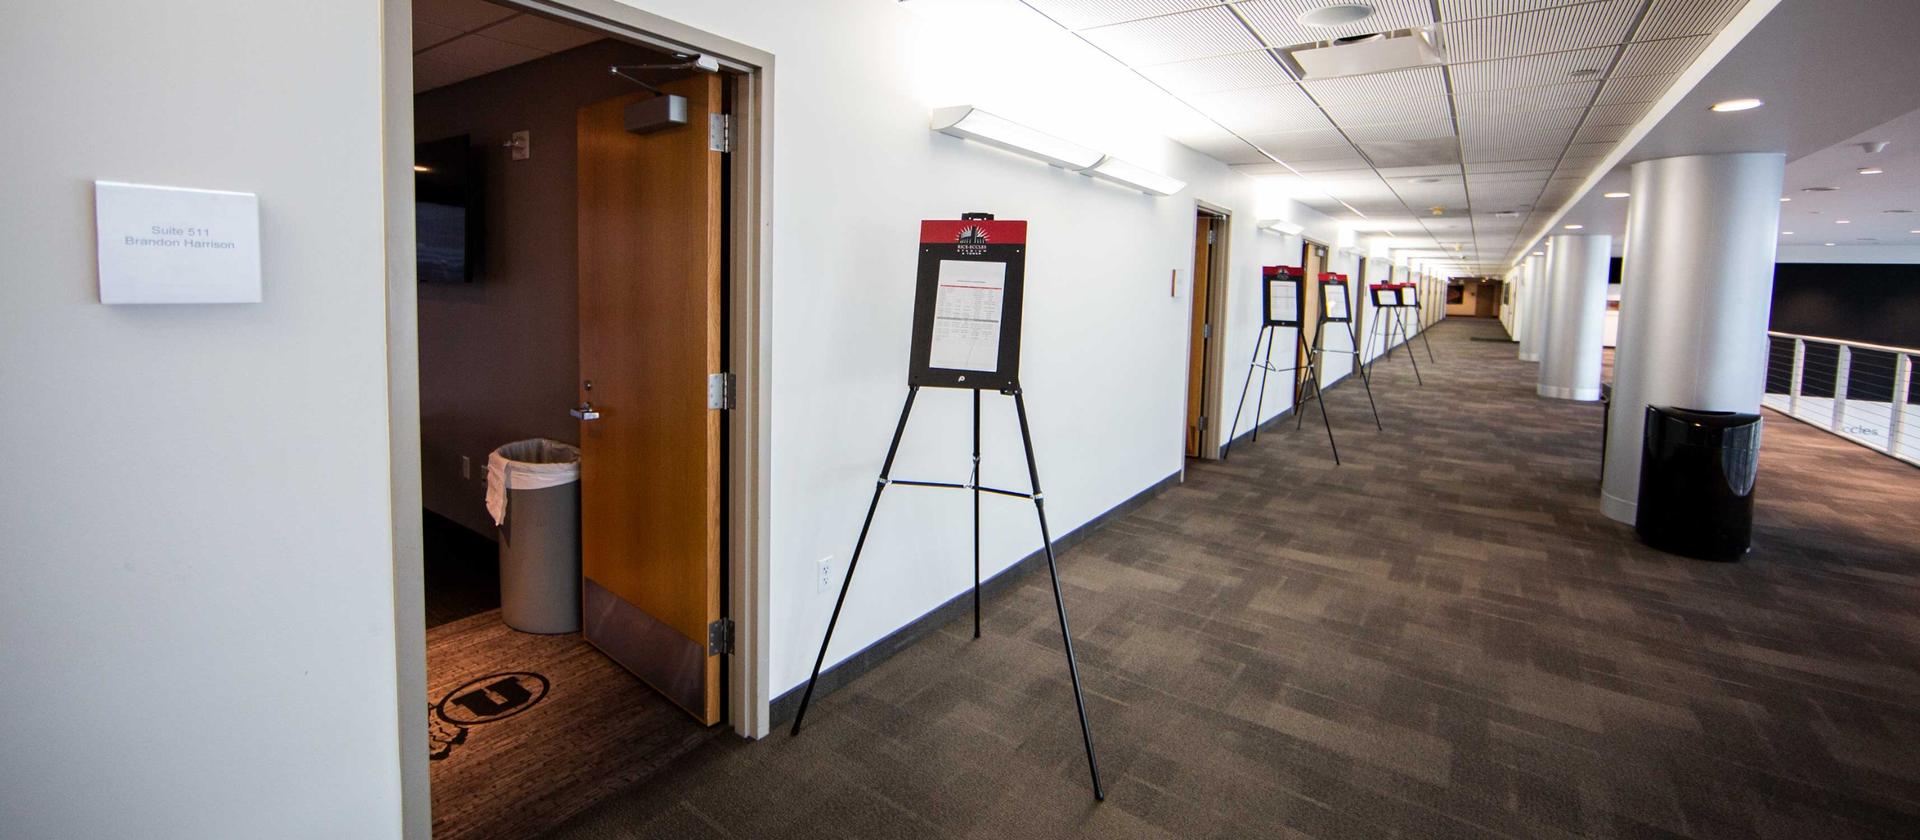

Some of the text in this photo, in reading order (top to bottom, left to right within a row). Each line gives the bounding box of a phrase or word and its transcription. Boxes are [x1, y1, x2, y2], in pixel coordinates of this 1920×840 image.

[151, 226, 209, 237] Suite 511
[124, 236, 235, 249] Brandon Harrison
